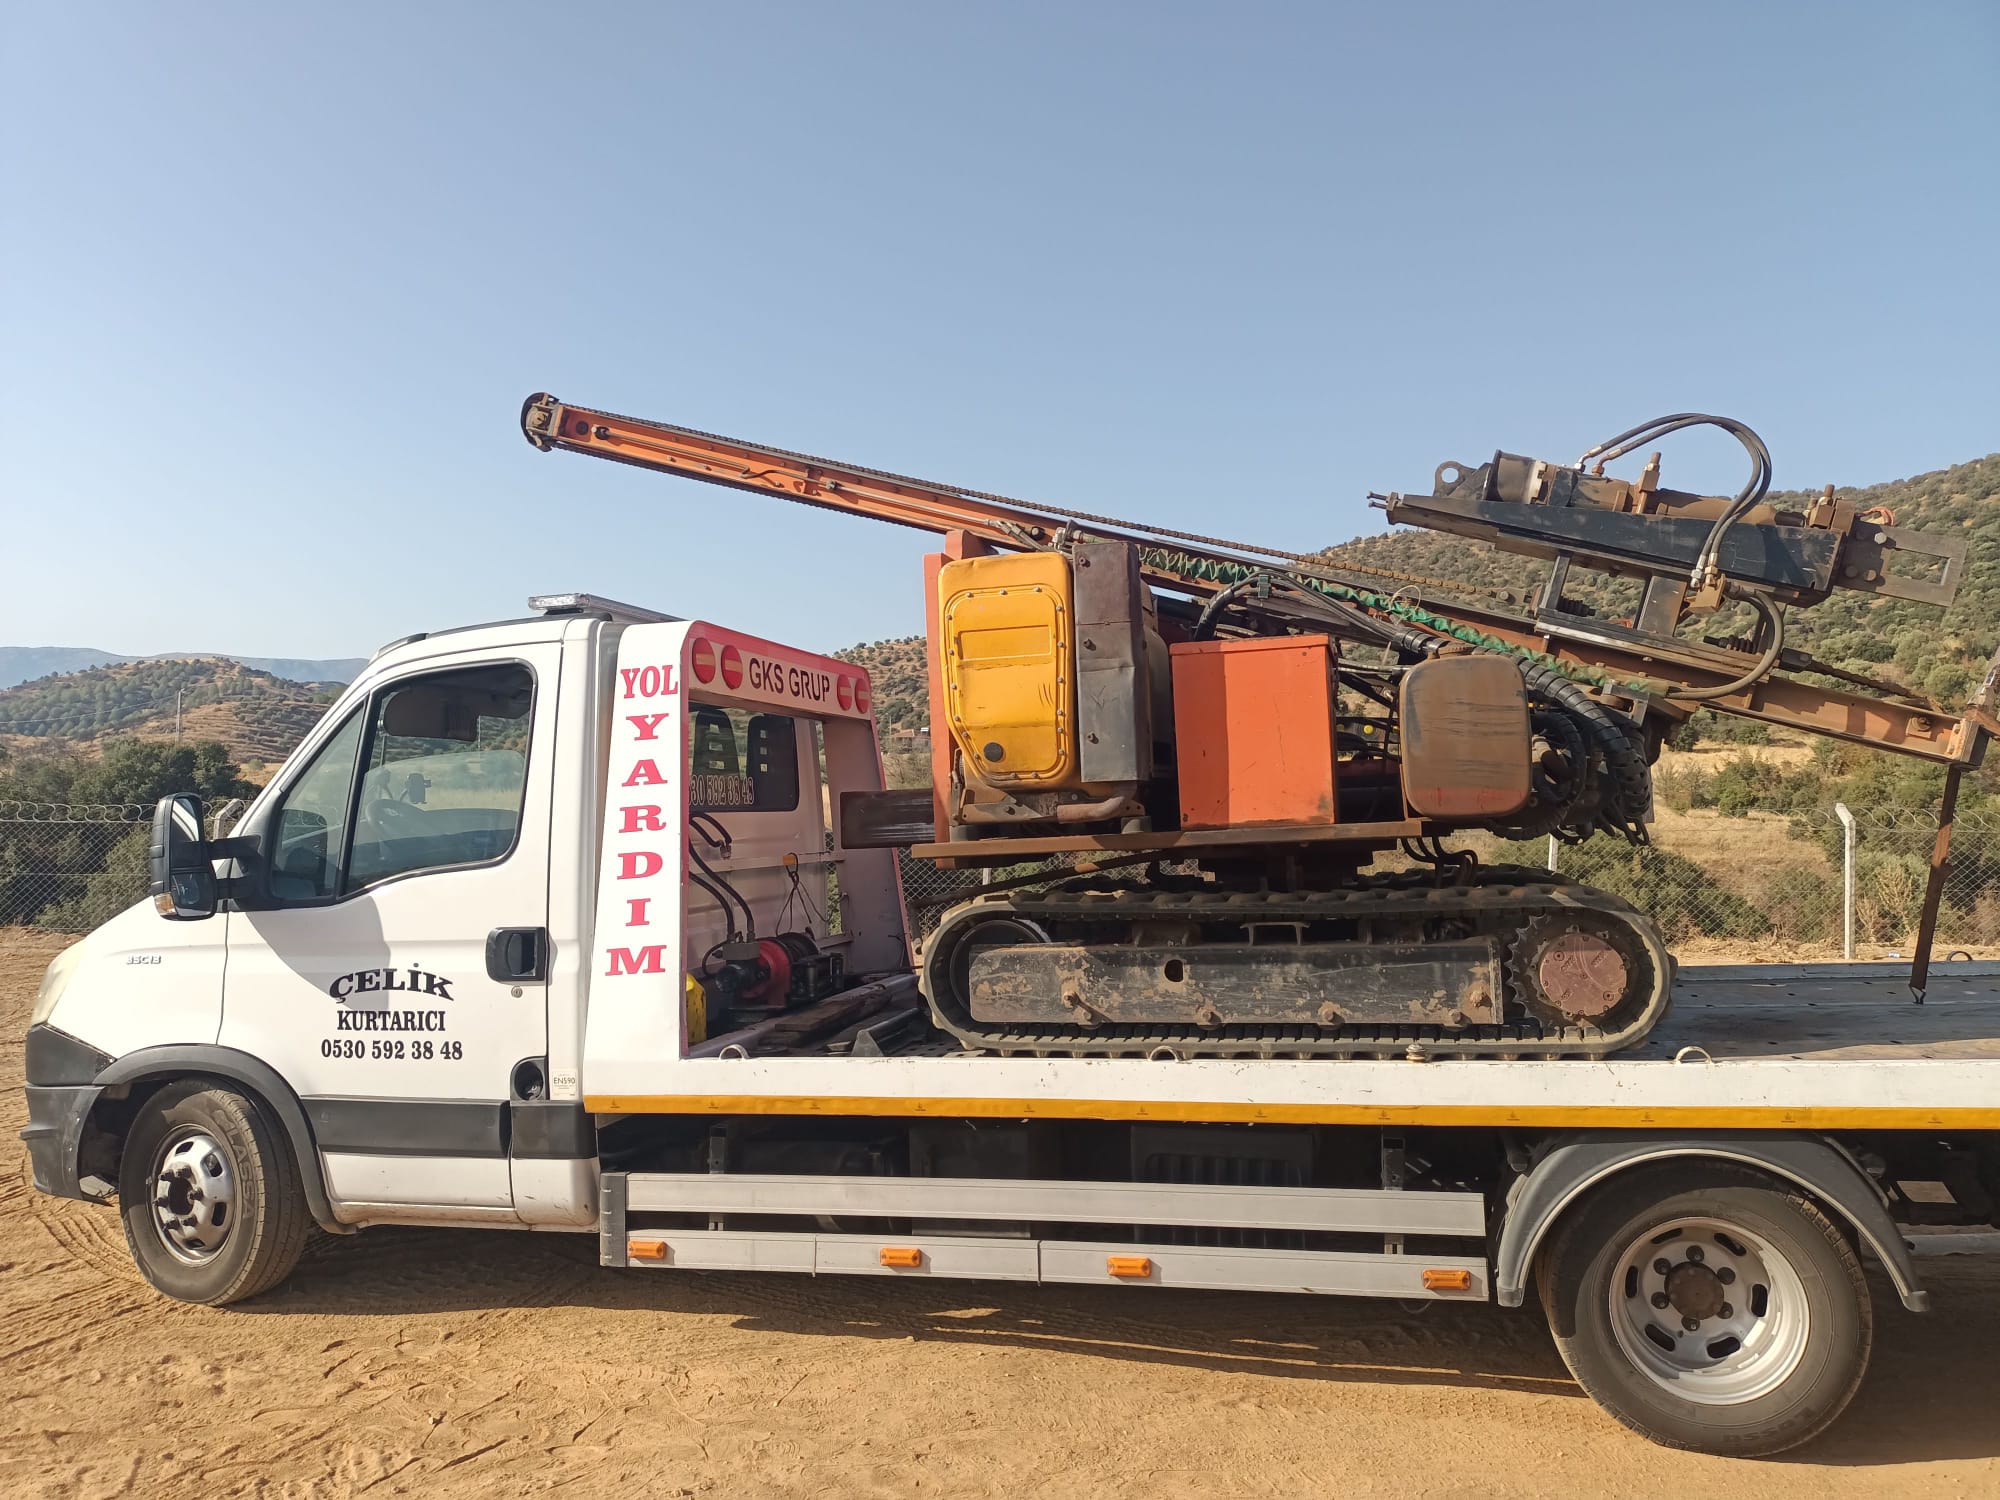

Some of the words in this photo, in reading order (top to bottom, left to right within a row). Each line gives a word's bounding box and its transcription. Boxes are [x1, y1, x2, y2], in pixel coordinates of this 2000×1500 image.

[620, 664, 679, 699] YOL
[749, 657, 784, 694] GKS
[789, 667, 830, 702] GRUP
[605, 713, 669, 976] YARDIM
[329, 962, 454, 1004] ÇELİK
[336, 1010, 446, 1031] KURTARICI
[321, 1039, 366, 1059] 0530
[371, 1040, 405, 1060] 592
[411, 1040, 434, 1060] 38
[439, 1041, 463, 1060] 48
[553, 1076, 576, 1085] EN590
